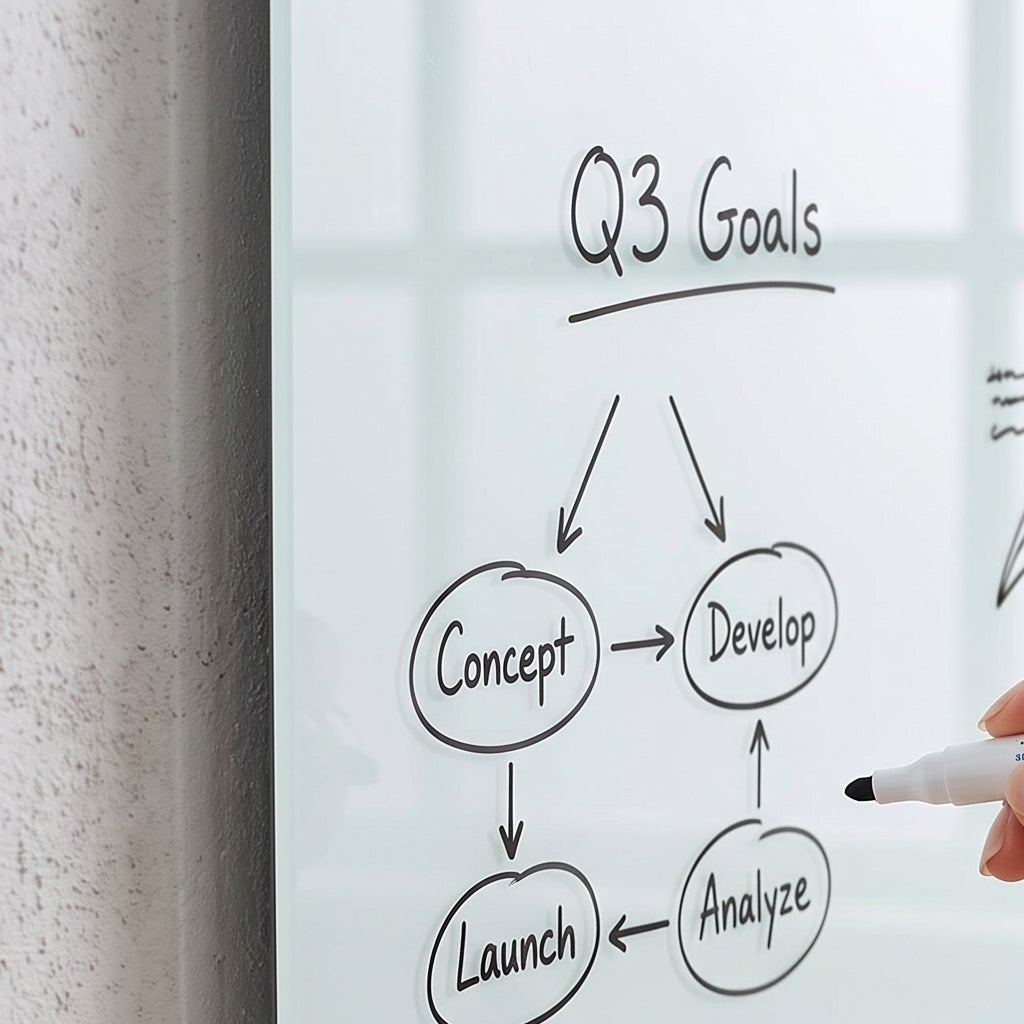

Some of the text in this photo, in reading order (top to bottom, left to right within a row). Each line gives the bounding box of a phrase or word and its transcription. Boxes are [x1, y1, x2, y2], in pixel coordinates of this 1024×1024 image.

[571, 146, 822, 277] Q3 Goals
[437, 616, 575, 706] Concept
[708, 596, 816, 667] Develop
[457, 905, 576, 991] Launch
[700, 868, 811, 949] Analyze
